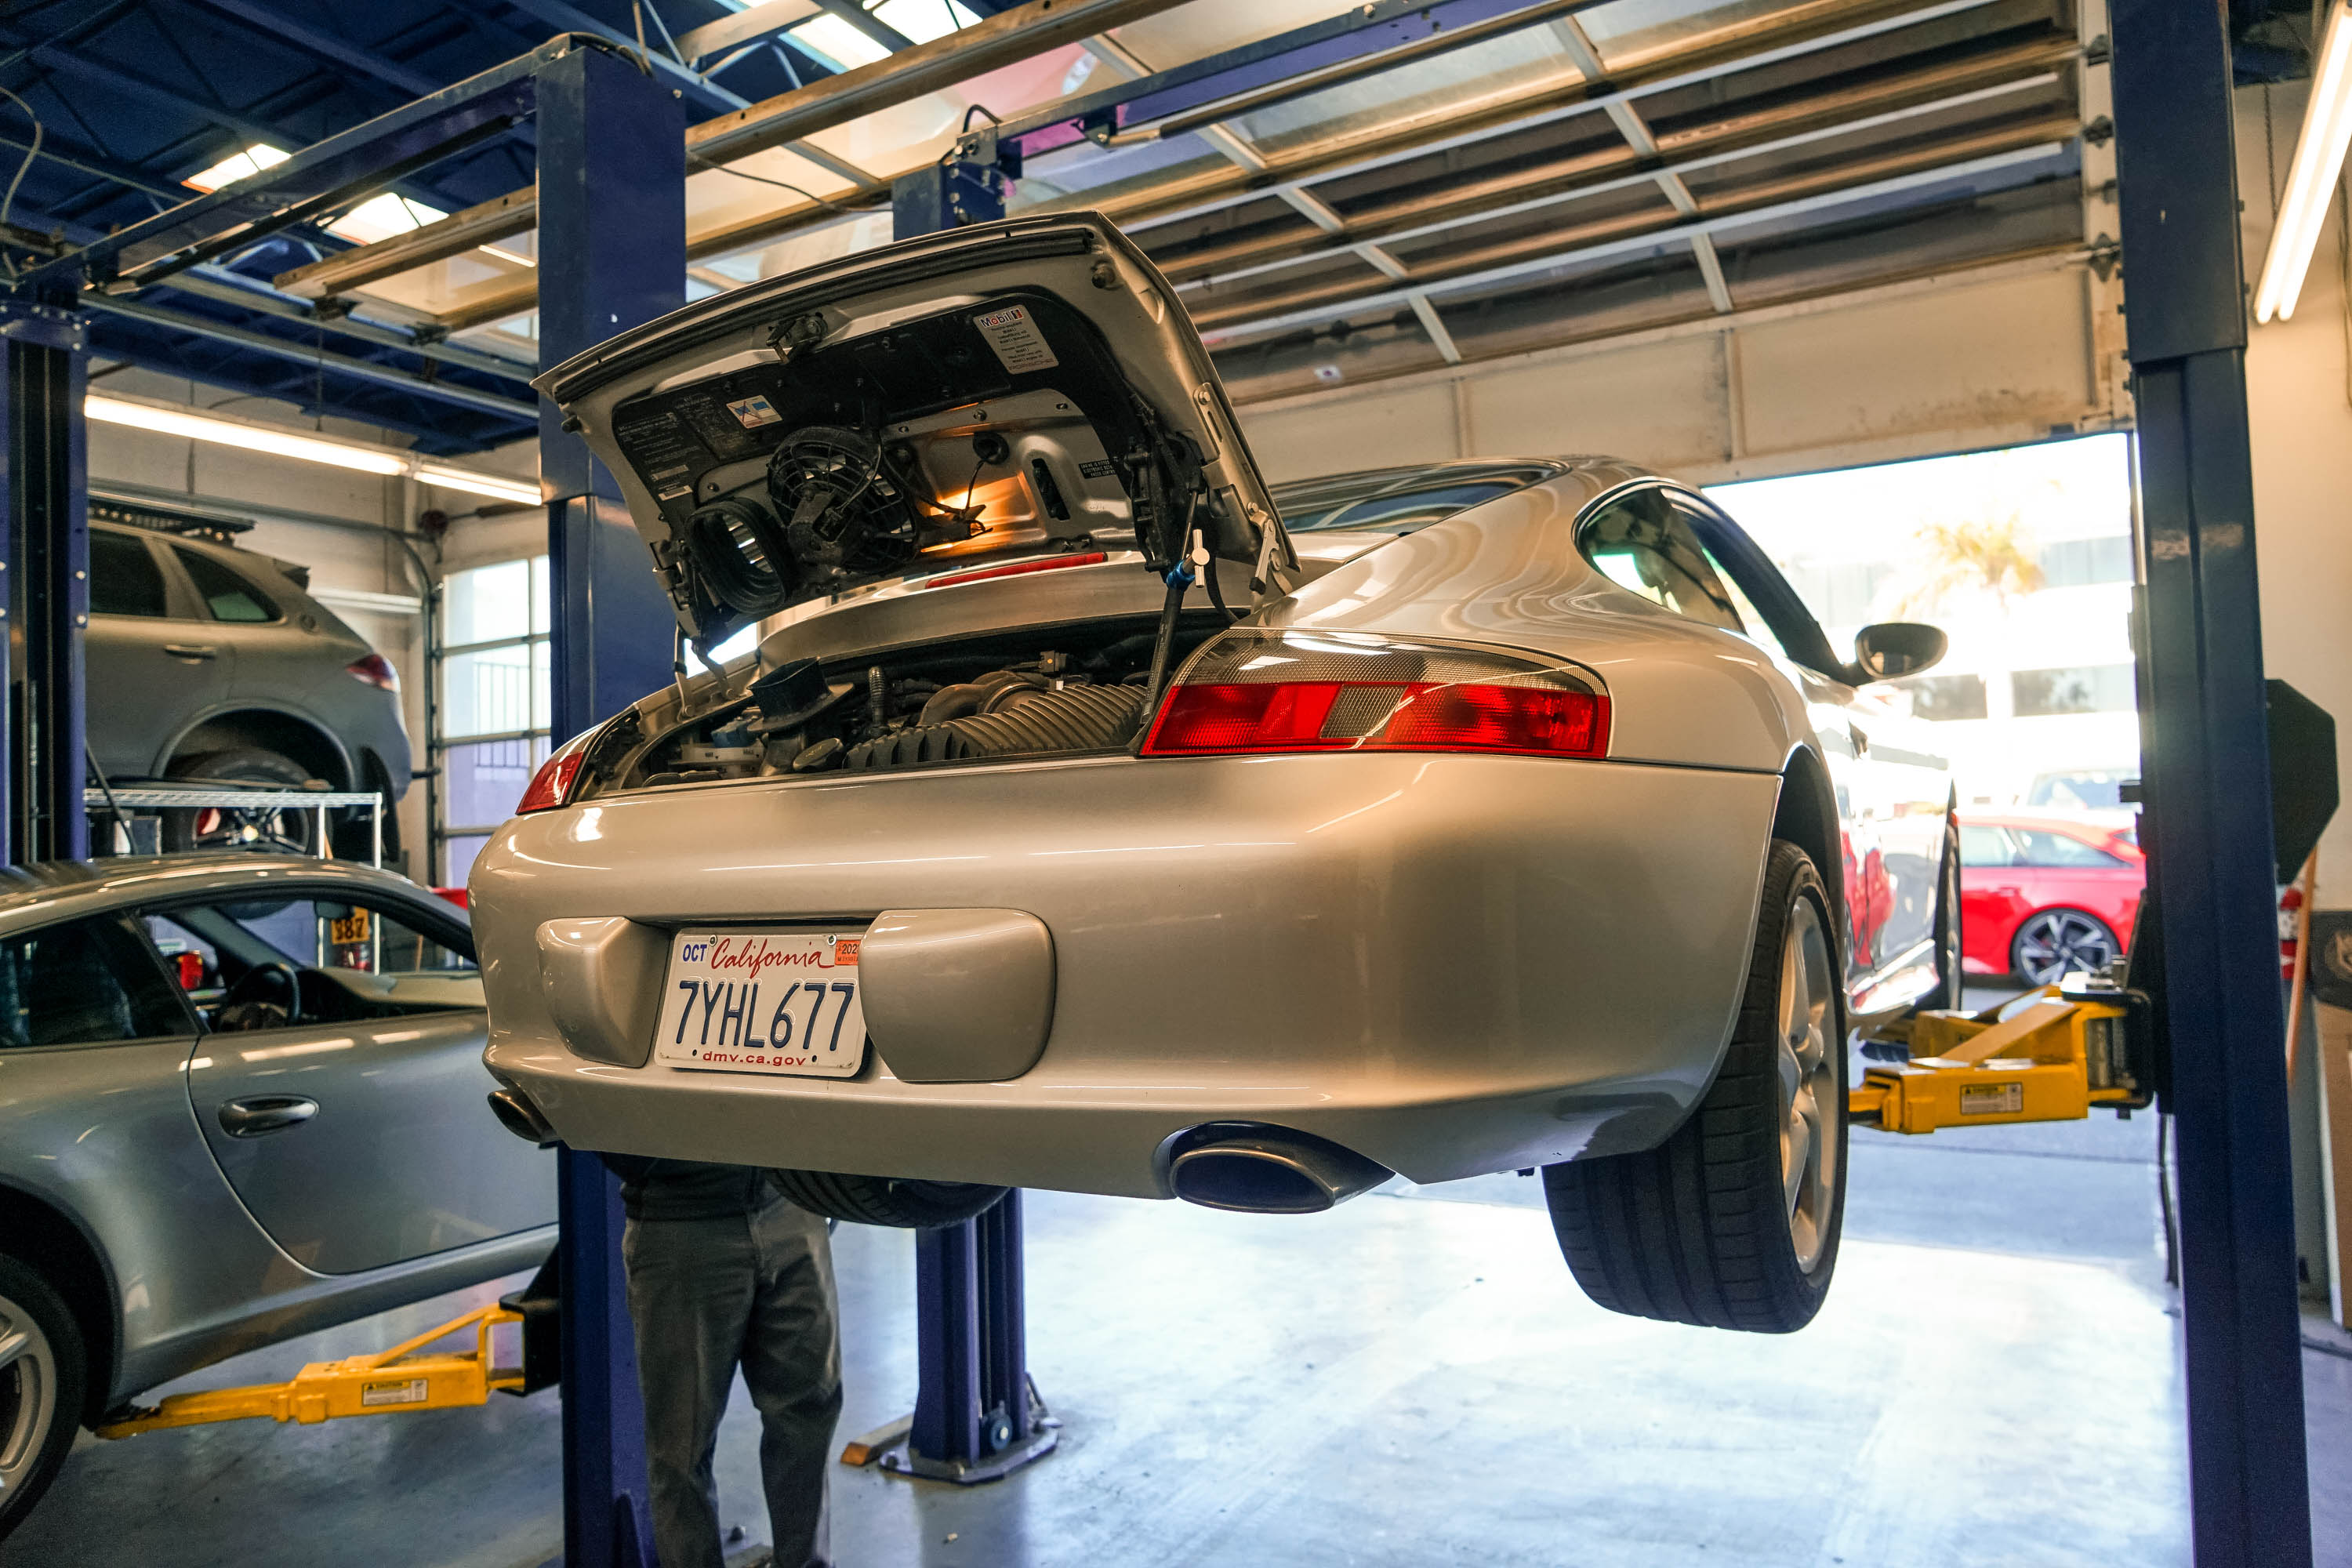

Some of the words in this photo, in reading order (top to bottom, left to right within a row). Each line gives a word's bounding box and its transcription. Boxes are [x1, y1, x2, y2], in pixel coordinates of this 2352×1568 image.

[980, 310, 1012, 328] Mobil
[841, 943, 860, 954] 202
[682, 943, 708, 963] OCT
[711, 938, 835, 979] California
[675, 980, 855, 1051] 7YHL677
[702, 1051, 807, 1067] dmv.ca.gov
